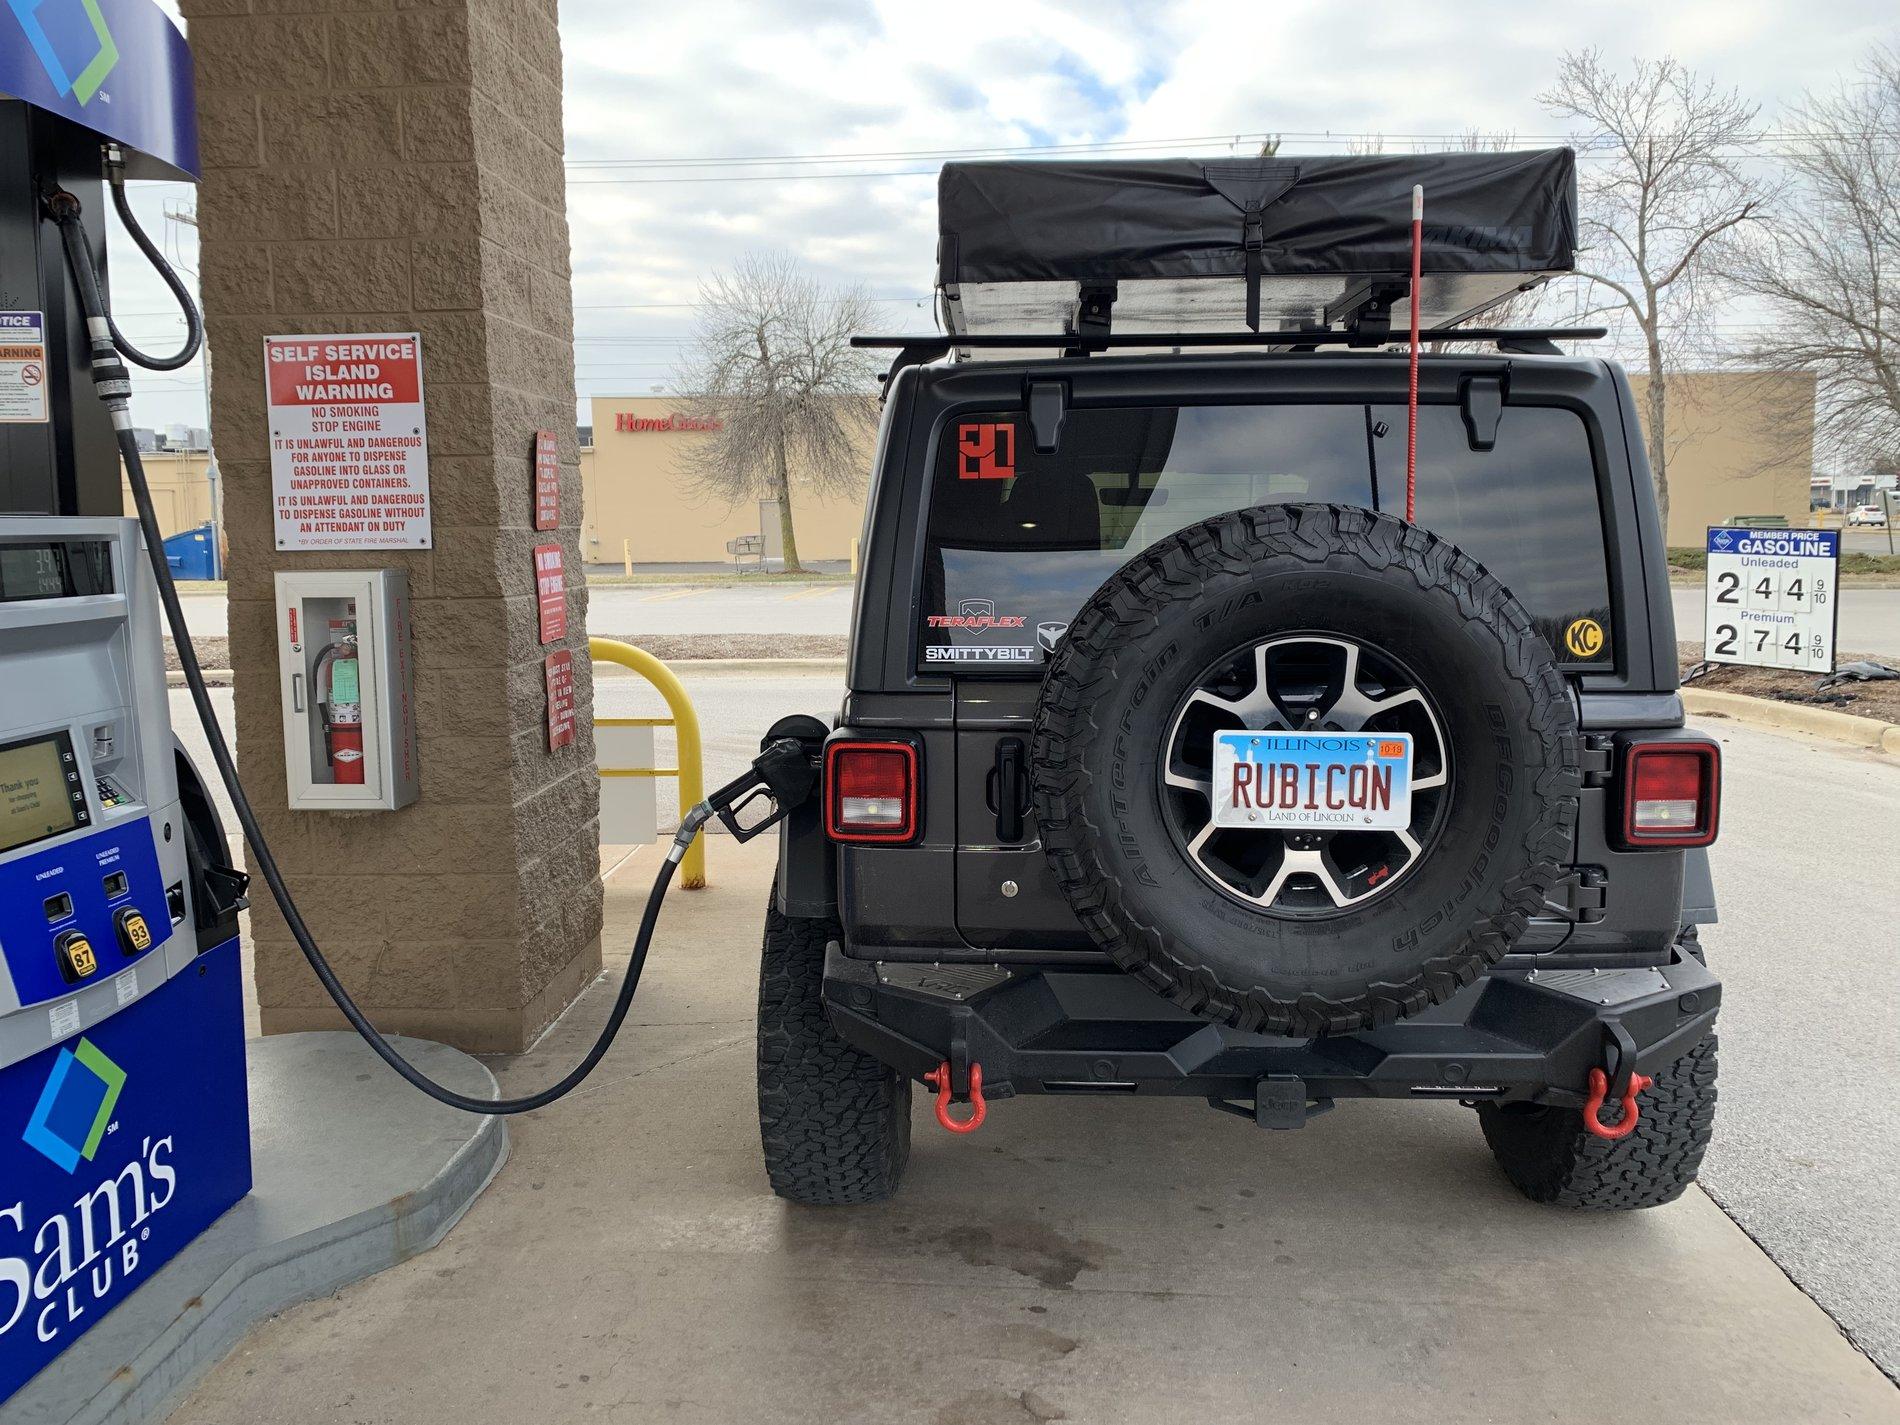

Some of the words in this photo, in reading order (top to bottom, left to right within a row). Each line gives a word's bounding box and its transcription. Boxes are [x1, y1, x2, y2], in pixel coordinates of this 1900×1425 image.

[270, 345, 319, 362] SELF
[325, 343, 414, 361] SERVICE
[305, 364, 380, 380] ISLAND
[295, 383, 394, 400] WARNING
[311, 406, 326, 418] NO
[330, 405, 379, 417] SMOKING
[312, 420, 339, 432] STOP
[343, 420, 381, 432] ENGINE
[274, 439, 283, 450] IT
[286, 439, 294, 450] IS
[297, 438, 345, 449] UNLAWFUL
[347, 438, 365, 448] AND
[368, 437, 422, 448] DANGEROUS
[291, 452, 309, 463] FOR
[312, 452, 346, 462] ANYONE
[350, 451, 361, 462] TO
[363, 450, 407, 461] DISPENSE
[294, 466, 337, 477] GASOLINE
[339, 465, 360, 476] INTO
[362, 464, 390, 475] GLASS
[393, 464, 406, 475] OR
[290, 479, 350, 490] UNAPPROVED
[352, 478, 411, 489] CONTAINERS.
[278, 496, 286, 506] IT
[289, 496, 298, 506] IS
[300, 495, 348, 506] UNLAWFUL
[350, 495, 369, 505] AND
[371, 494, 425, 505] DANGEROUS
[279, 509, 291, 520] TO
[293, 509, 336, 520] DISPENSE
[339, 508, 382, 519] GASOLINE
[385, 507, 425, 518] WITHOUT
[300, 522, 312, 533] AN
[315, 522, 365, 533] ATTENDANT
[368, 521, 380, 532] ON
[383, 521, 406, 531] DUTY
[1749, 531, 1789, 541] MEMBER
[1791, 532, 1820, 541] PRICE
[1738, 540, 1831, 556] GASOLINE
[1741, 557, 1799, 569] Unleaded
[927, 616, 1028, 628] TERAFLEX
[1740, 611, 1795, 624] Premium
[1571, 622, 1598, 653] KC
[925, 648, 1034, 660] SMITTYBILT
[1267, 738, 1360, 751] ILLINOIS
[0, 780, 22, 793] Thank
[25, 778, 39, 790] you
[1268, 810, 1297, 822] LAND
[1299, 812, 1312, 822] OF
[1313, 811, 1354, 823] LINCOLN
[1391, 704, 1514, 953] BFGoodrich
[96, 846, 120, 860] UNLEADED
[98, 854, 121, 867] PREMIUM
[35, 866, 64, 881] UNLEADED
[131, 925, 147, 942] 93
[73, 949, 91, 968] 87
[0, 1135, 176, 1335] Sam's
